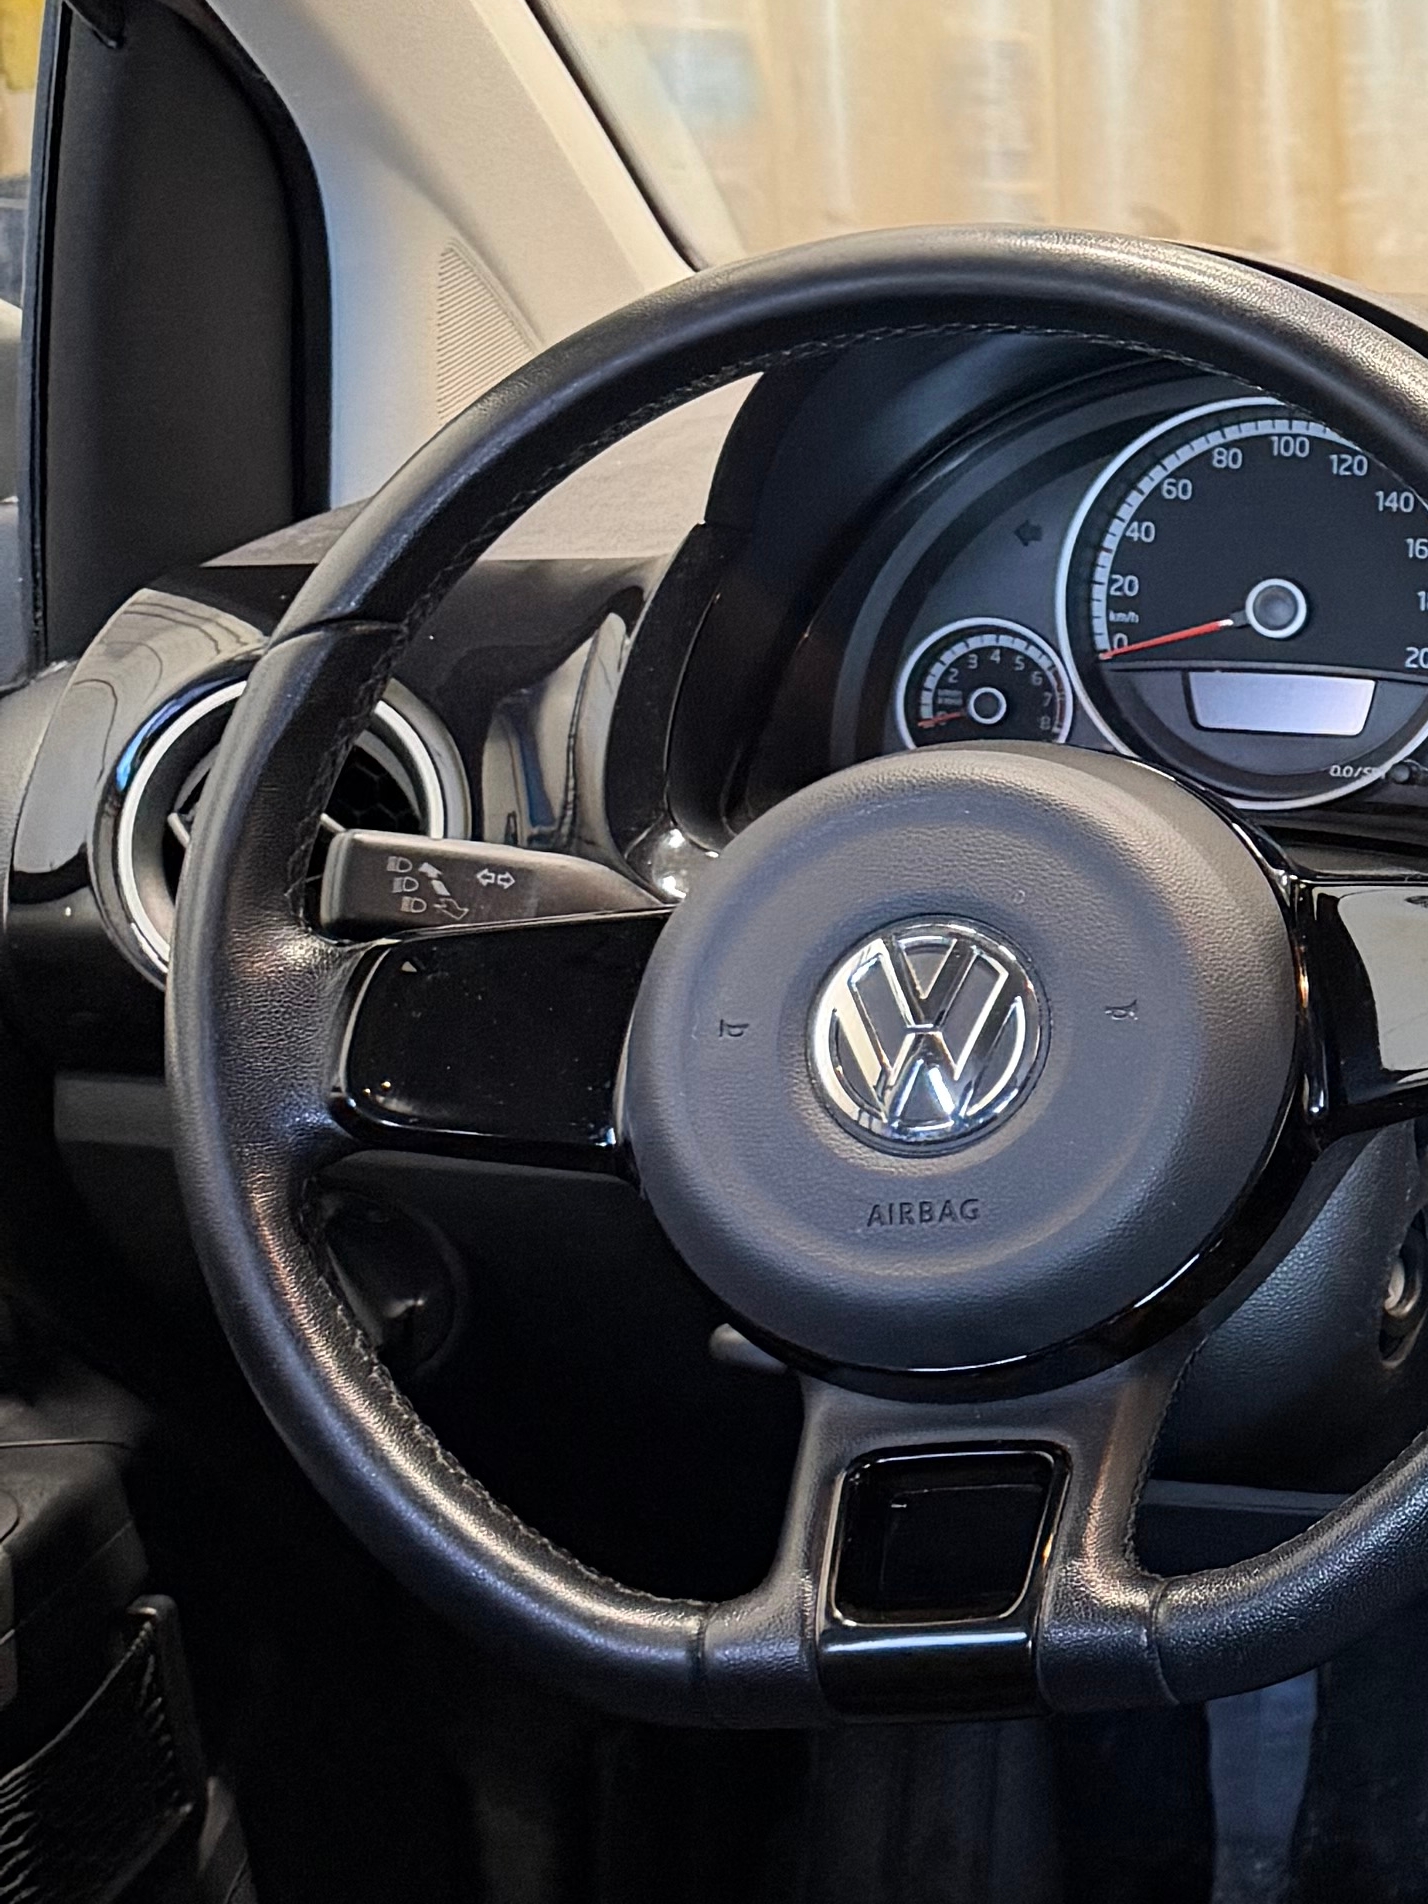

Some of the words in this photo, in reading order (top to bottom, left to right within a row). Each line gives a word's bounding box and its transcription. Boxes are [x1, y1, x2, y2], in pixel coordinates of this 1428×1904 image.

[1271, 435, 1310, 458] 100
[1212, 447, 1243, 469] 80
[1329, 453, 1368, 477] 120
[1161, 478, 1192, 500] 60
[1375, 490, 1415, 513] 140
[1125, 521, 1156, 543] 40
[1109, 574, 1140, 597] 20
[1109, 610, 1140, 624] km/h
[967, 653, 979, 670] 3
[989, 648, 1002, 665] 4
[1014, 655, 1026, 672] 5
[948, 667, 960, 684] 2
[1031, 670, 1044, 687] 6
[1043, 691, 1053, 708] 7
[866, 1198, 980, 1227] AIRBAG
